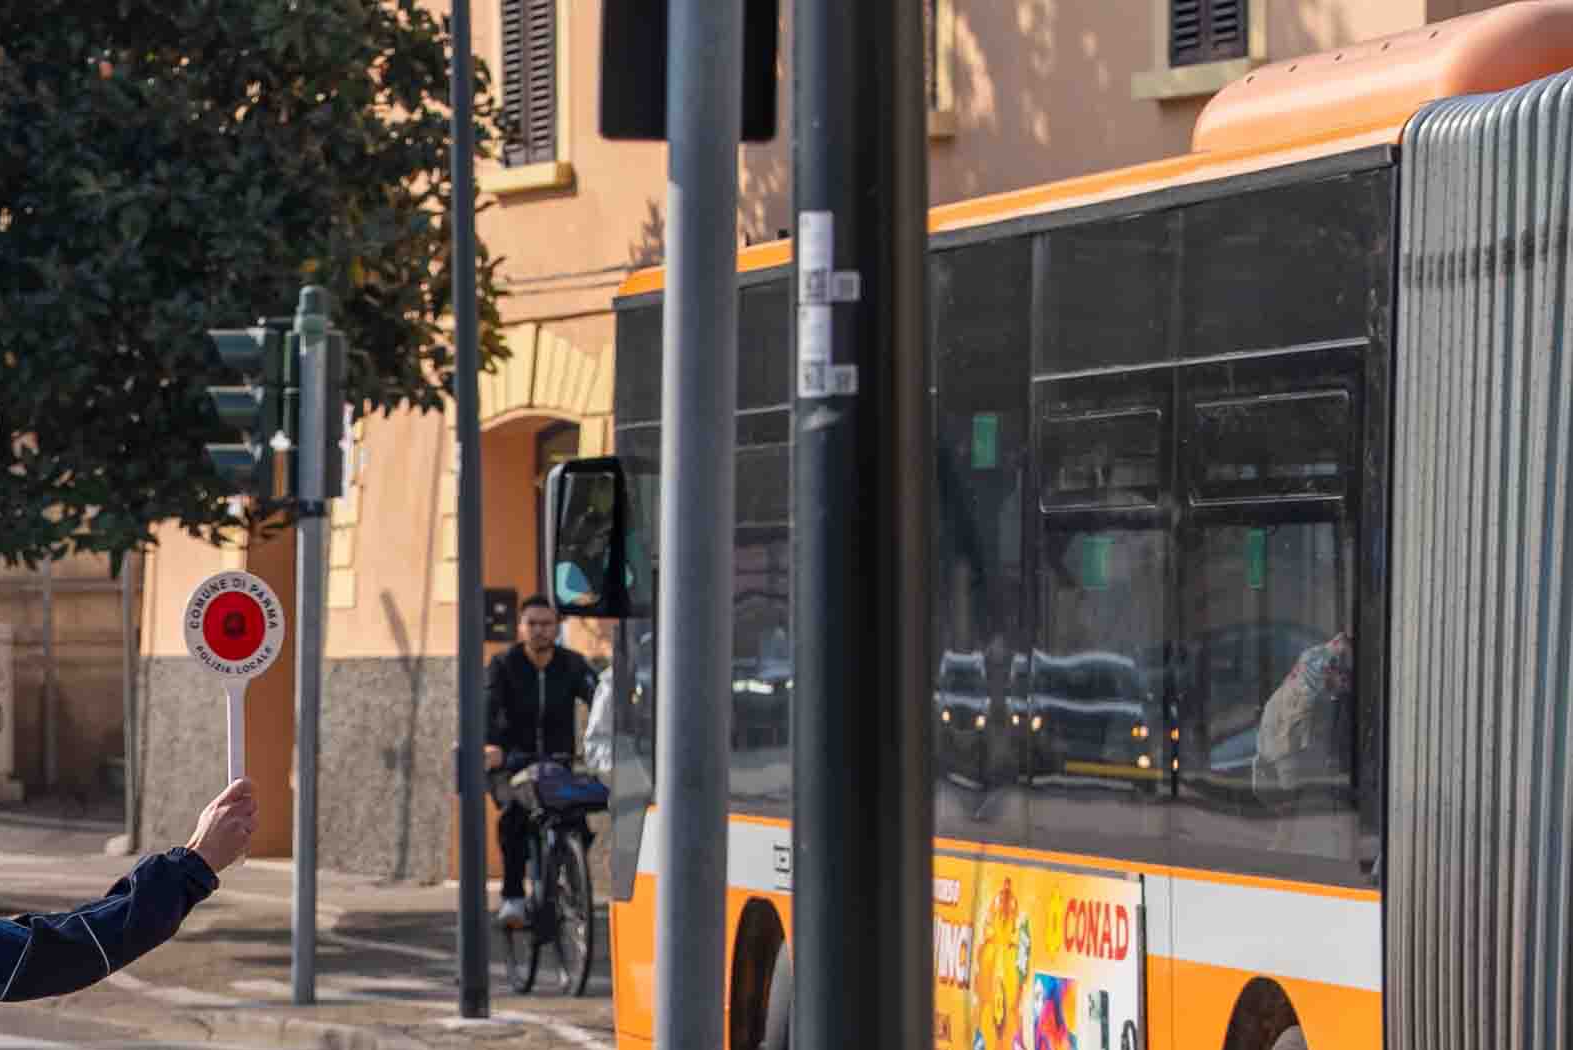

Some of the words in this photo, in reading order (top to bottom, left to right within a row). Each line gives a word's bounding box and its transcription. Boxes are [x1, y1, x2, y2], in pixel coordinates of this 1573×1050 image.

[190, 578, 228, 629] COMUNE
[232, 577, 246, 589] DI
[250, 584, 279, 629] PARMA
[195, 645, 231, 674] POLIZIA
[235, 645, 272, 674] LOCALE
[1064, 898, 1129, 961] CONAD
